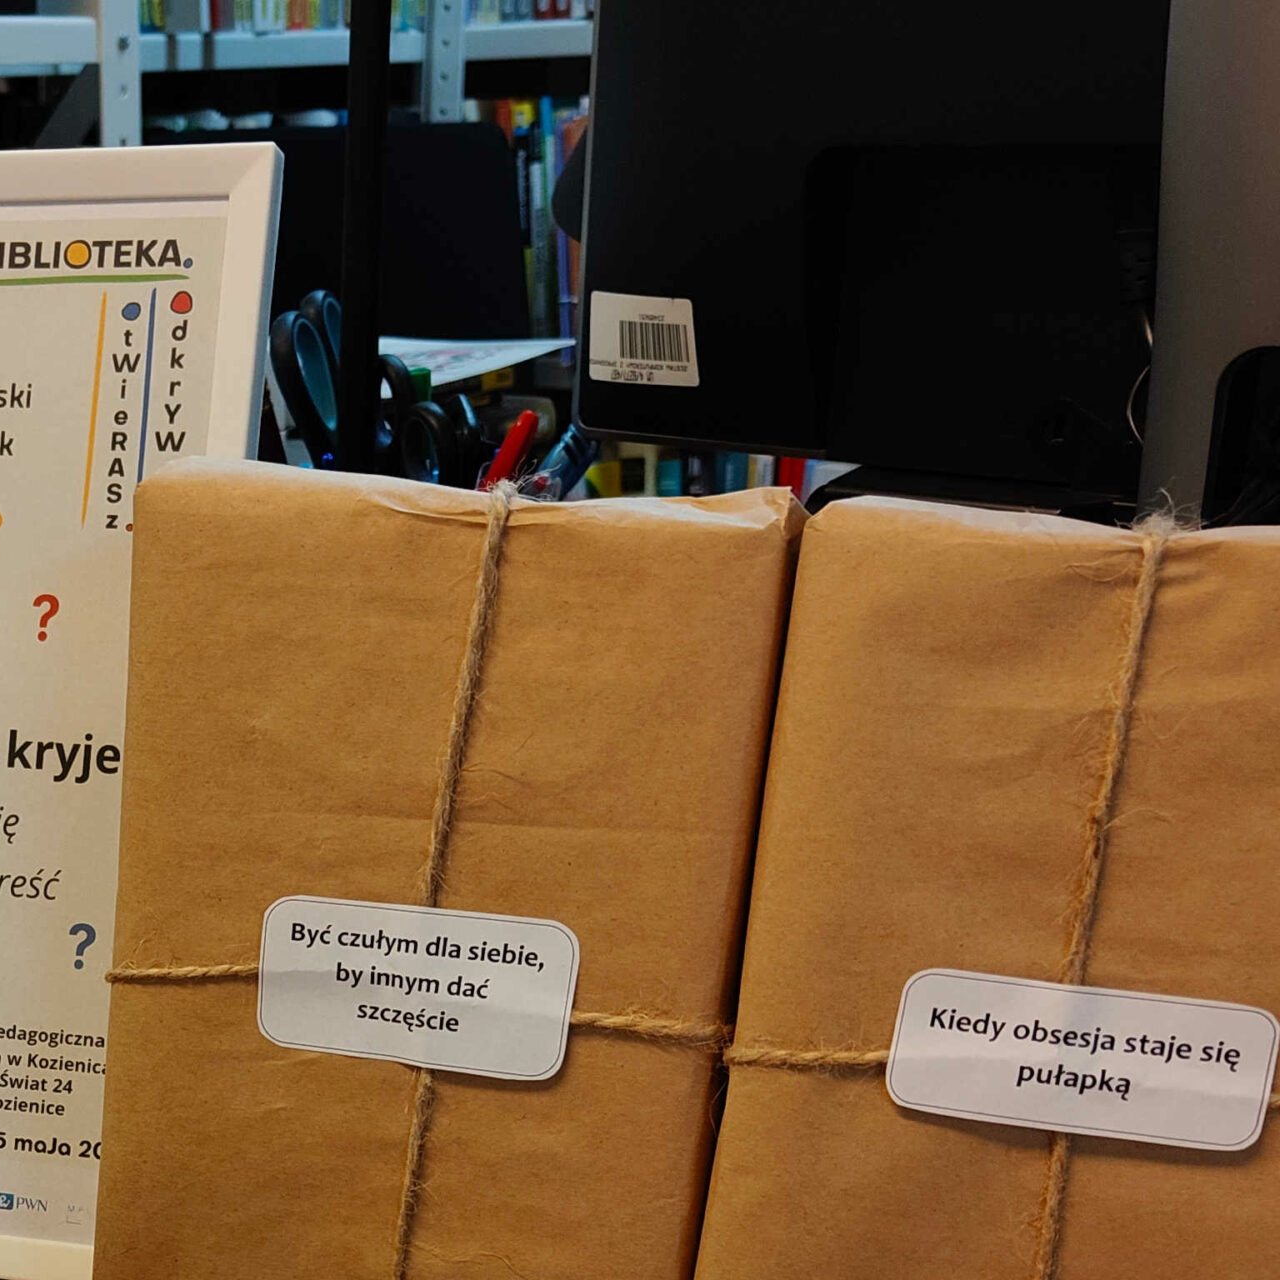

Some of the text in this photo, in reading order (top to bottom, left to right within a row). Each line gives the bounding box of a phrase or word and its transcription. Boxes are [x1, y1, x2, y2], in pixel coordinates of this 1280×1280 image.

[33, 594, 60, 642] ?
[8, 730, 120, 783] kryje
[69, 923, 96, 970] ?
[290, 922, 545, 973] Być czułym dla siebie,
[336, 962, 490, 999] by innym dać
[356, 1003, 460, 1032] szczęście
[929, 1007, 1241, 1072] Kiedy obsesja staje się
[8, 1054, 22, 1067] w
[0, 1072, 47, 1092] Świat
[52, 1079, 73, 1094] 24
[1016, 1064, 1132, 1100] pułapką
[16, 1197, 48, 1212] PWN
